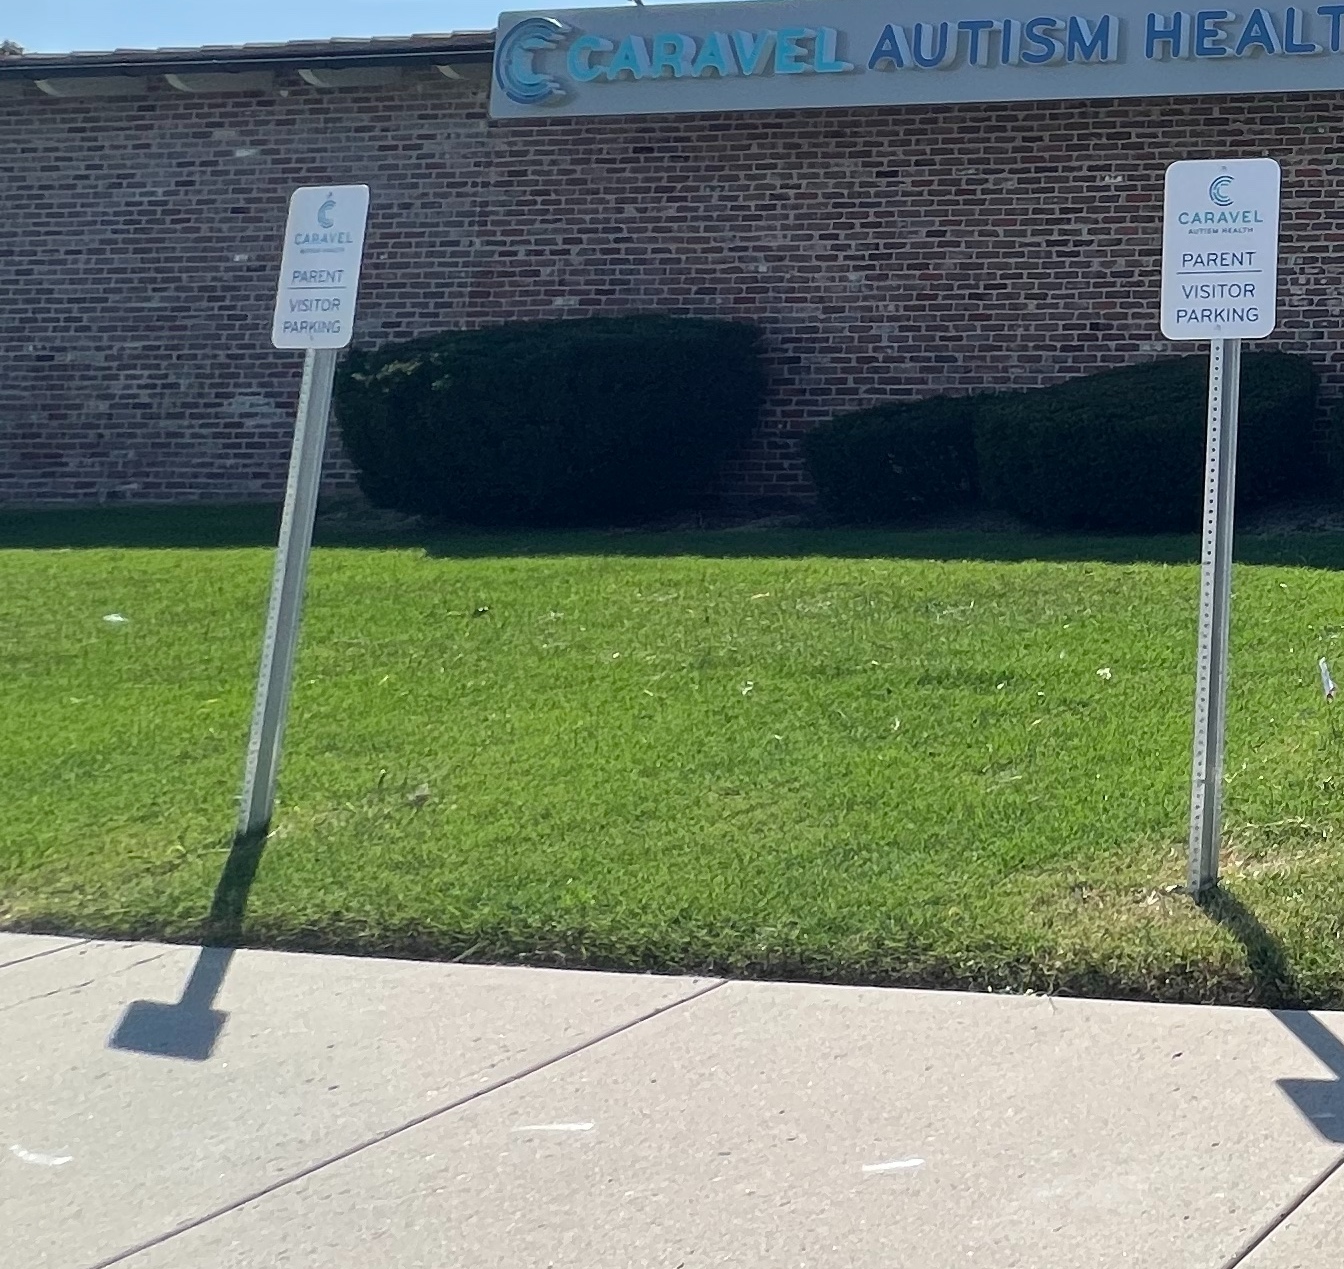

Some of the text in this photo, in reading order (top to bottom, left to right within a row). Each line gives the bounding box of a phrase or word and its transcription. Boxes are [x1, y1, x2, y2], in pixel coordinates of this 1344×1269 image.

[566, 26, 852, 82] CARAVEL
[868, 15, 1117, 71] AUTISM
[1177, 209, 1264, 226] CARAVEL
[294, 231, 354, 246] CARAVEL
[1182, 251, 1257, 268] PARENT
[291, 269, 345, 284] PARENT
[1181, 283, 1256, 300] VISITOR
[288, 297, 342, 314] VISITOR
[1176, 306, 1260, 325] PARKING
[282, 319, 342, 334] PARKING
